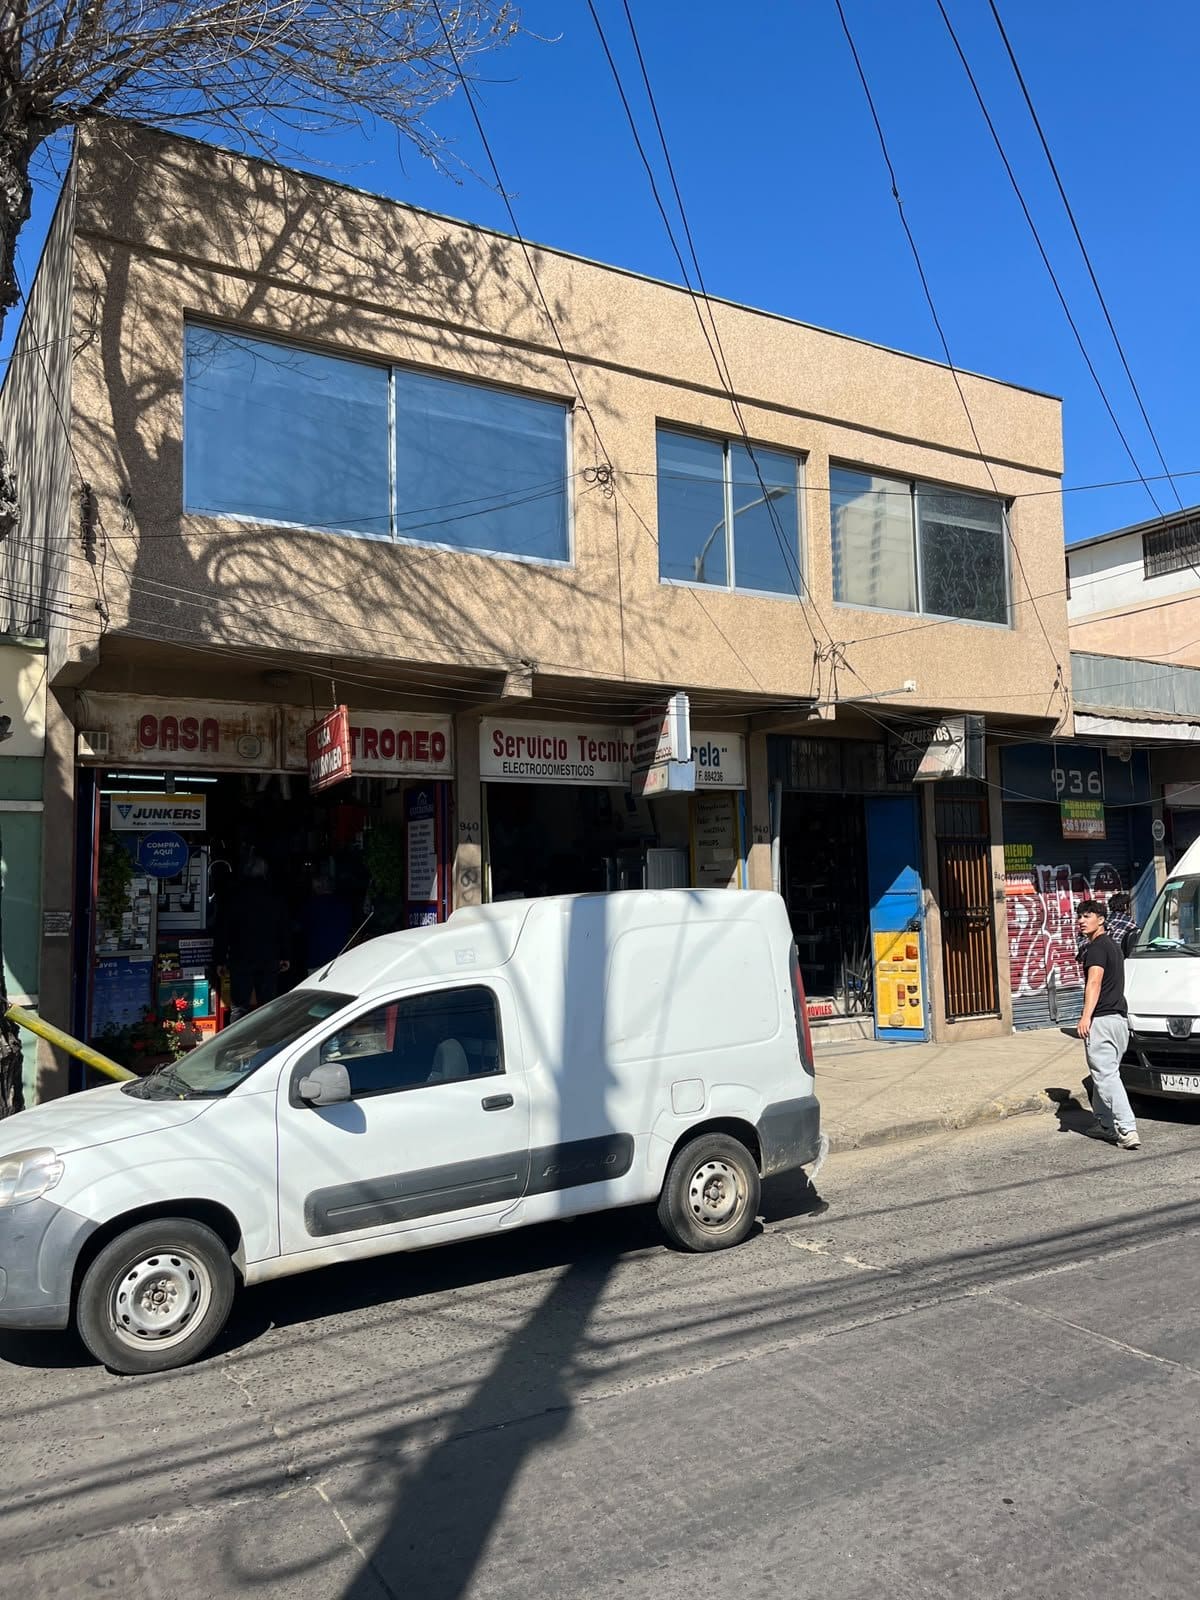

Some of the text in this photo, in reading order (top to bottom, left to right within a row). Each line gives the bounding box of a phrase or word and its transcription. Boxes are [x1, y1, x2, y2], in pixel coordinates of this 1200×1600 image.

[138, 714, 219, 752] CASA
[317, 727, 331, 749] CASA
[902, 726, 950, 744] REPUESTOS
[349, 726, 446, 762] TRONEO
[492, 729, 568, 761] Servicio
[691, 741, 728, 767] rela"
[311, 746, 342, 782] COTRONEO
[502, 761, 595, 777] ELECTRODOMESTICOS
[1051, 768, 1101, 794] 936
[133, 808, 201, 819] JUNKERS
[459, 822, 479, 831] 940
[466, 834, 472, 843] A
[154, 848, 173, 856] AQUÍ
[1004, 844, 1033, 857] RIENDO
[806, 1004, 833, 1017] MOVILES
